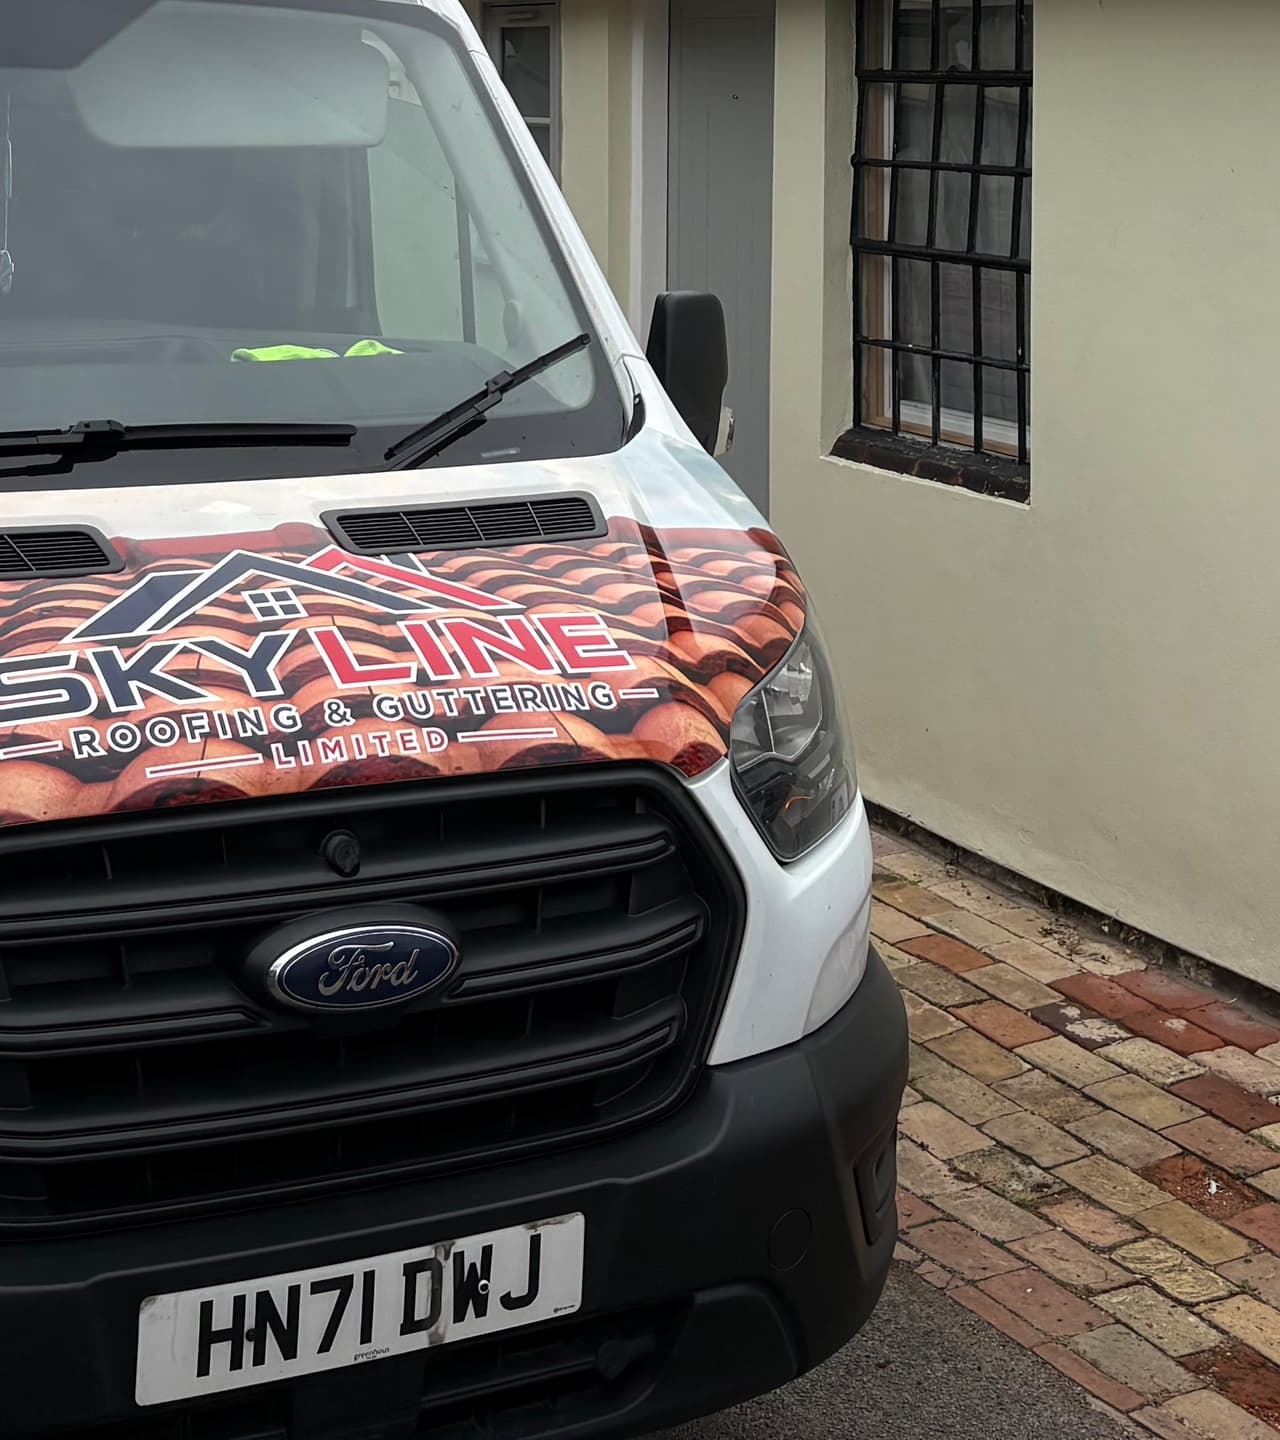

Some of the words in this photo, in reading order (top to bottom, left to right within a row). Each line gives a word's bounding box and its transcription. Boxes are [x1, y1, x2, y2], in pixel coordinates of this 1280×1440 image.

[71, 704, 301, 760] ROOFING
[324, 698, 357, 727] &
[370, 681, 616, 722] GUTTERING
[272, 727, 451, 771] LIMITED
[318, 941, 420, 997] Ford
[195, 1269, 376, 1379] HN71
[399, 1232, 542, 1337] DWJ
